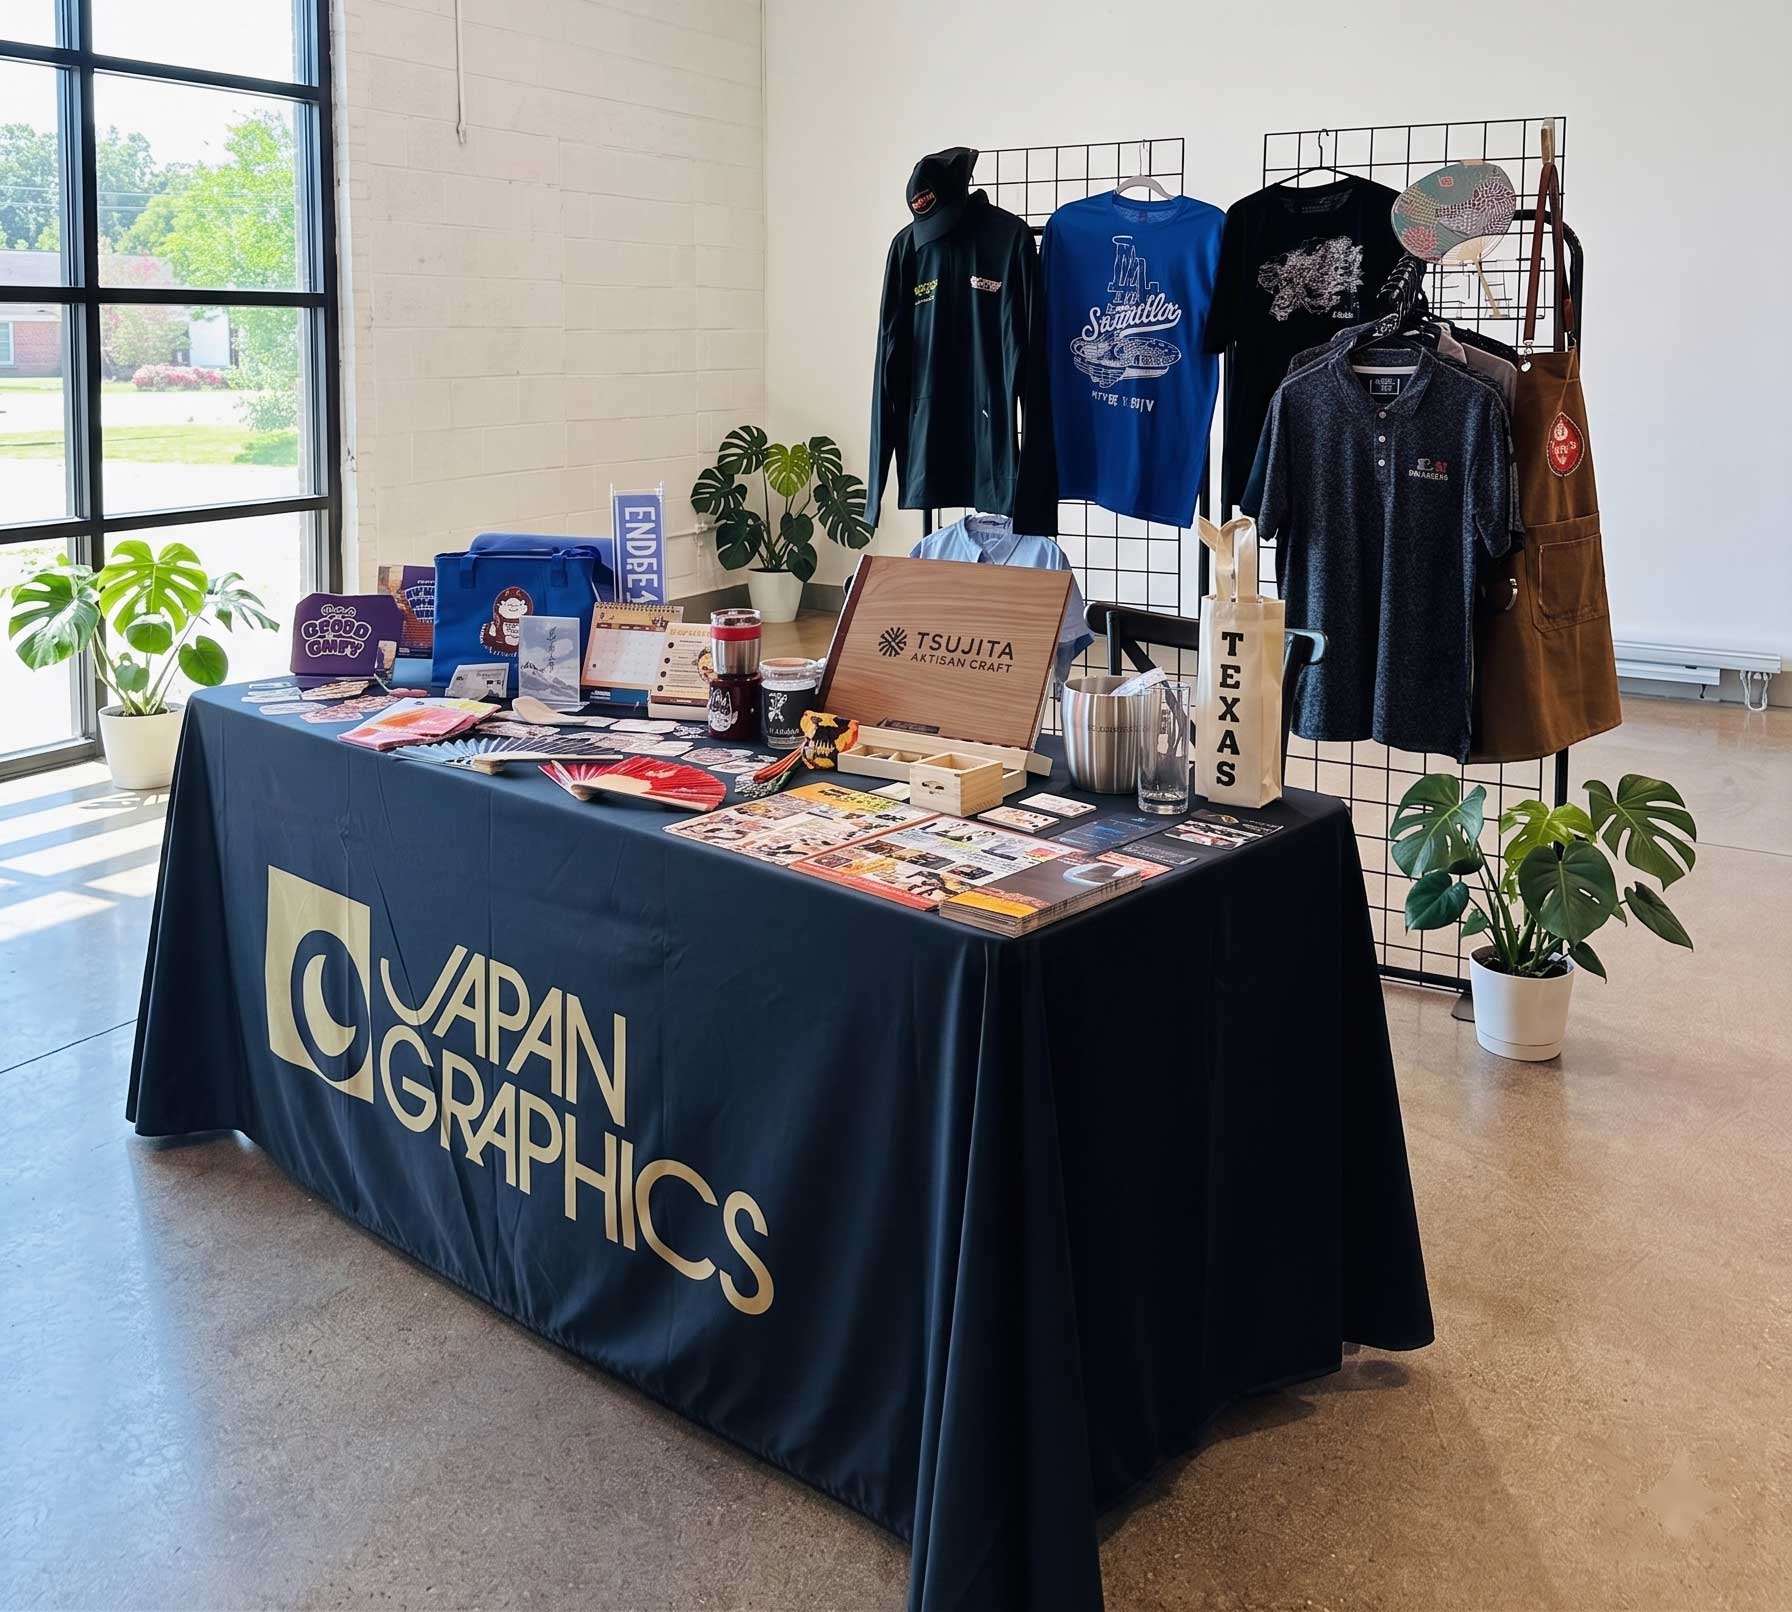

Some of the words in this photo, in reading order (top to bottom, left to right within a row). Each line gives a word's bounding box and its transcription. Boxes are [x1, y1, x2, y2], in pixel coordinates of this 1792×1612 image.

[917, 631, 1014, 660] TSUJITA
[969, 659, 1012, 673] CRAFT
[1215, 631, 1244, 787] TEXAS
[380, 944, 627, 1128] JAPAN
[379, 1024, 775, 1316] GRAPHICS
